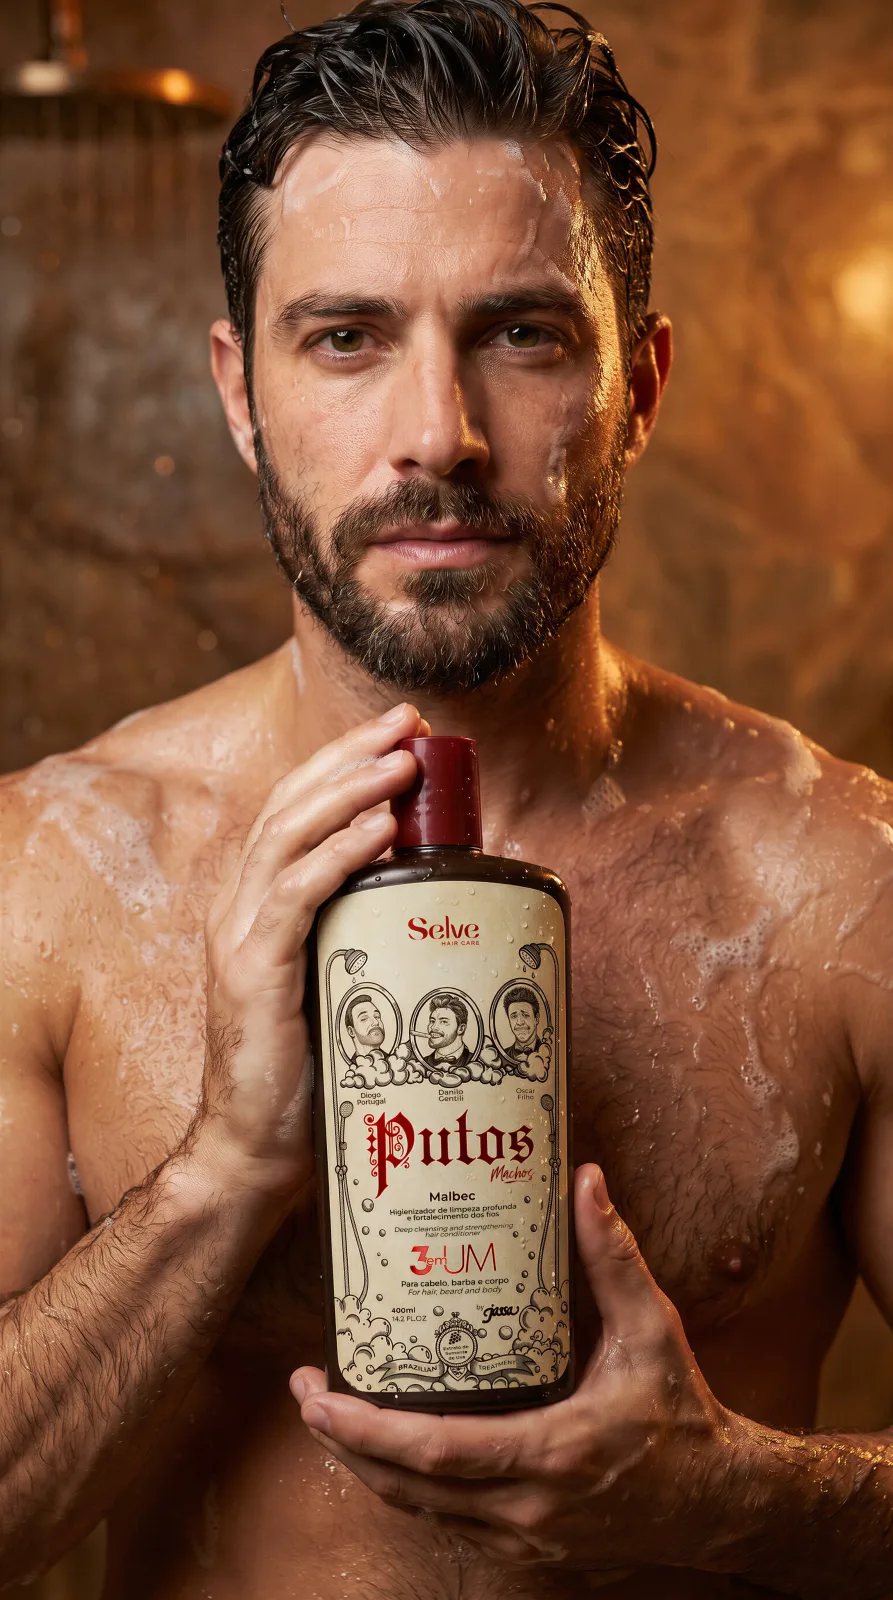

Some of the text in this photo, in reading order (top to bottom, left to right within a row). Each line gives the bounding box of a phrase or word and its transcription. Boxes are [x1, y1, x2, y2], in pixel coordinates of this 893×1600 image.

[408, 915, 480, 940] Selve
[356, 1098, 386, 1106] Portugal
[363, 1109, 535, 1199] Putos
[490, 1165, 535, 1184] Machos
[429, 1191, 476, 1202] Malbec
[389, 1208, 436, 1216] Higienizador
[449, 1206, 481, 1215] limpeza
[482, 1203, 517, 1213] profunda
[413, 1213, 469, 1221] fortalecimento
[394, 1226, 413, 1234] Deep
[414, 1225, 449, 1233] cleansing
[464, 1223, 514, 1231] strengthening
[425, 1230, 481, 1238] hair conditioner
[409, 1242, 497, 1276] 3 em UM
[420, 1279, 450, 1287] cabelo,
[484, 1277, 510, 1285] corpo
[421, 1288, 438, 1296] hair,
[439, 1287, 463, 1295] beard
[464, 1286, 481, 1294] and
[481, 1286, 503, 1295] body
[391, 1306, 416, 1314] 400ml
[398, 1360, 516, 1373] BRAZILIAN TREATMENT
